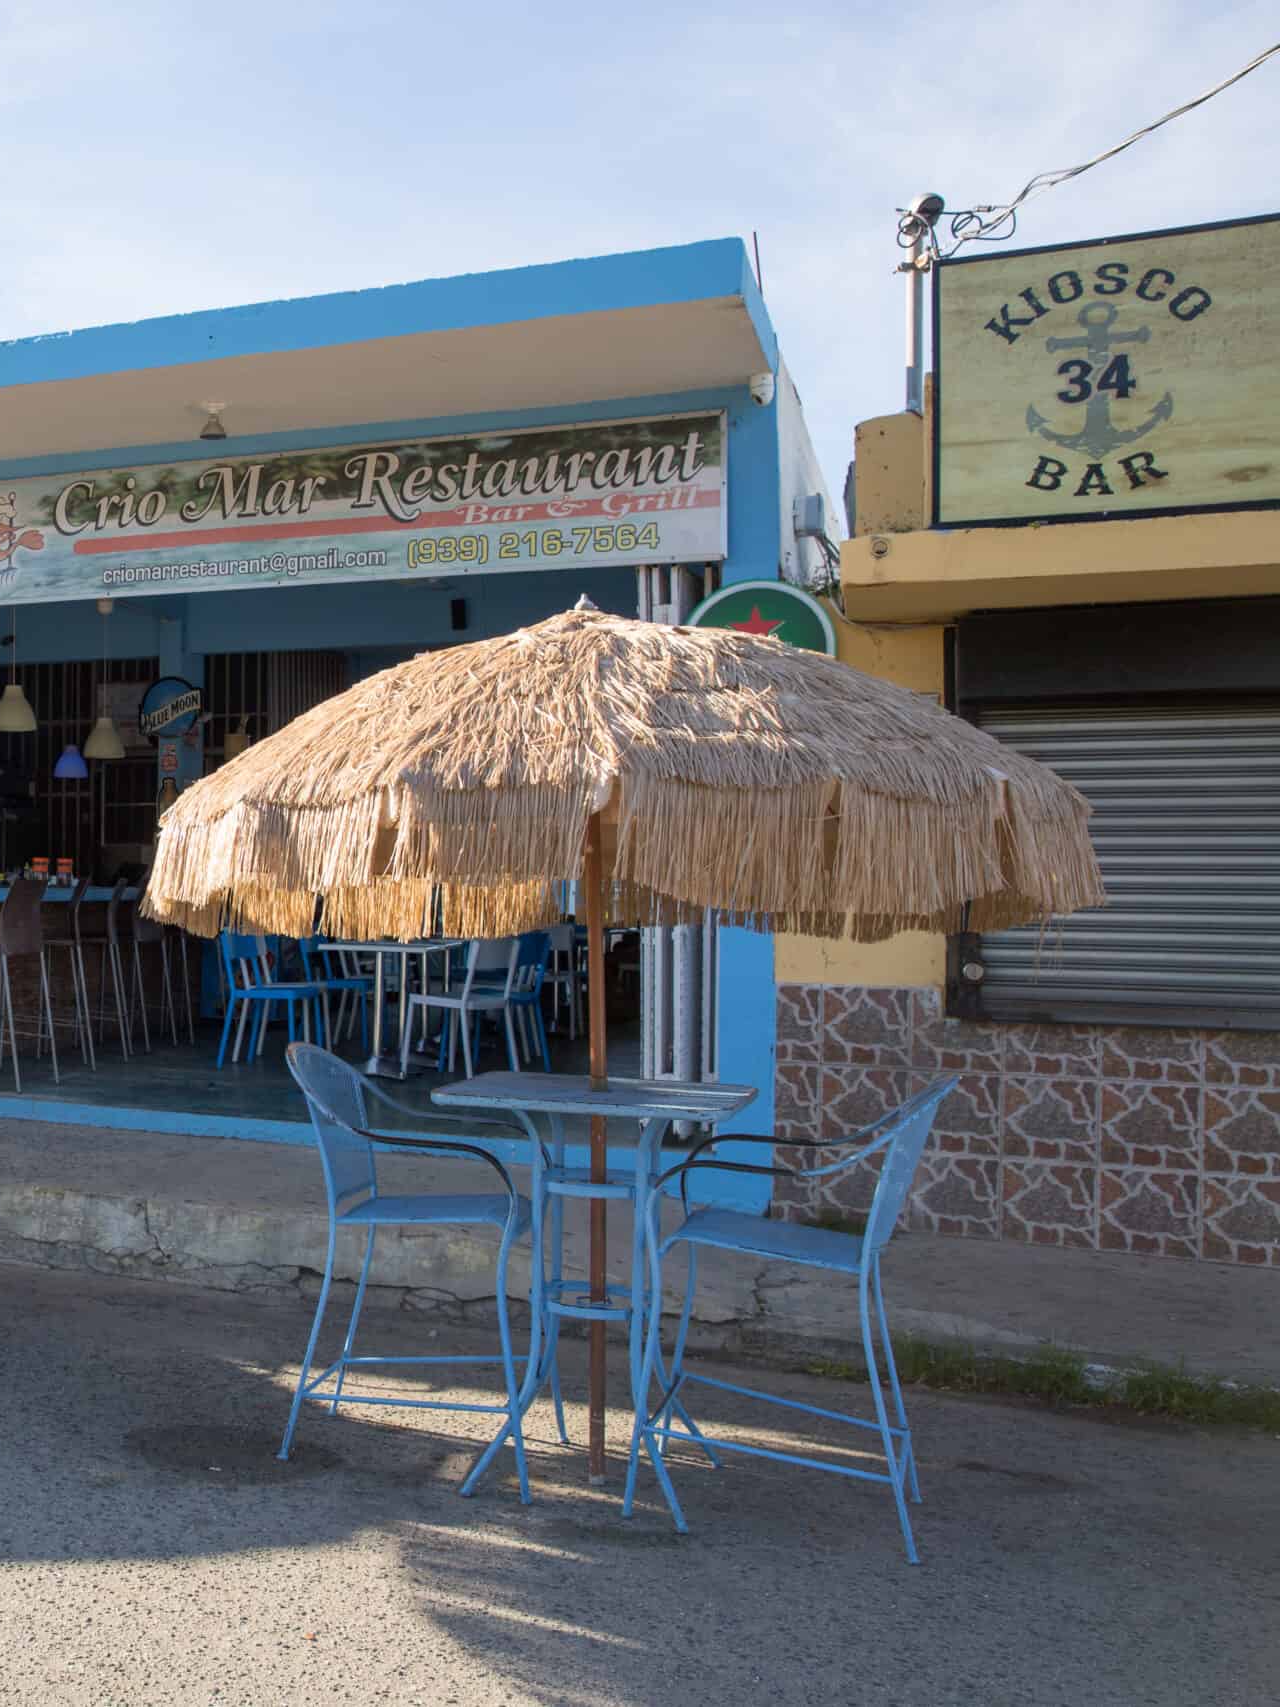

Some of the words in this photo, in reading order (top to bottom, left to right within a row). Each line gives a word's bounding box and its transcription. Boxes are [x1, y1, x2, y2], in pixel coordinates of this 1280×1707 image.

[984, 263, 1212, 345] KIOSCO
[1057, 354, 1136, 403] 34
[54, 476, 167, 536] Crio
[180, 463, 327, 523] Mar
[344, 432, 705, 523] Restaurant
[1025, 451, 1169, 496] BAR
[456, 503, 535, 526] Bar
[546, 494, 588, 518] &
[600, 485, 700, 520] Grill
[102, 547, 387, 584] criomarrestaurant@gmail.com
[407, 536, 490, 568] (939)
[498, 521, 660, 559] 216-7564
[174, 692, 199, 714] MOON
